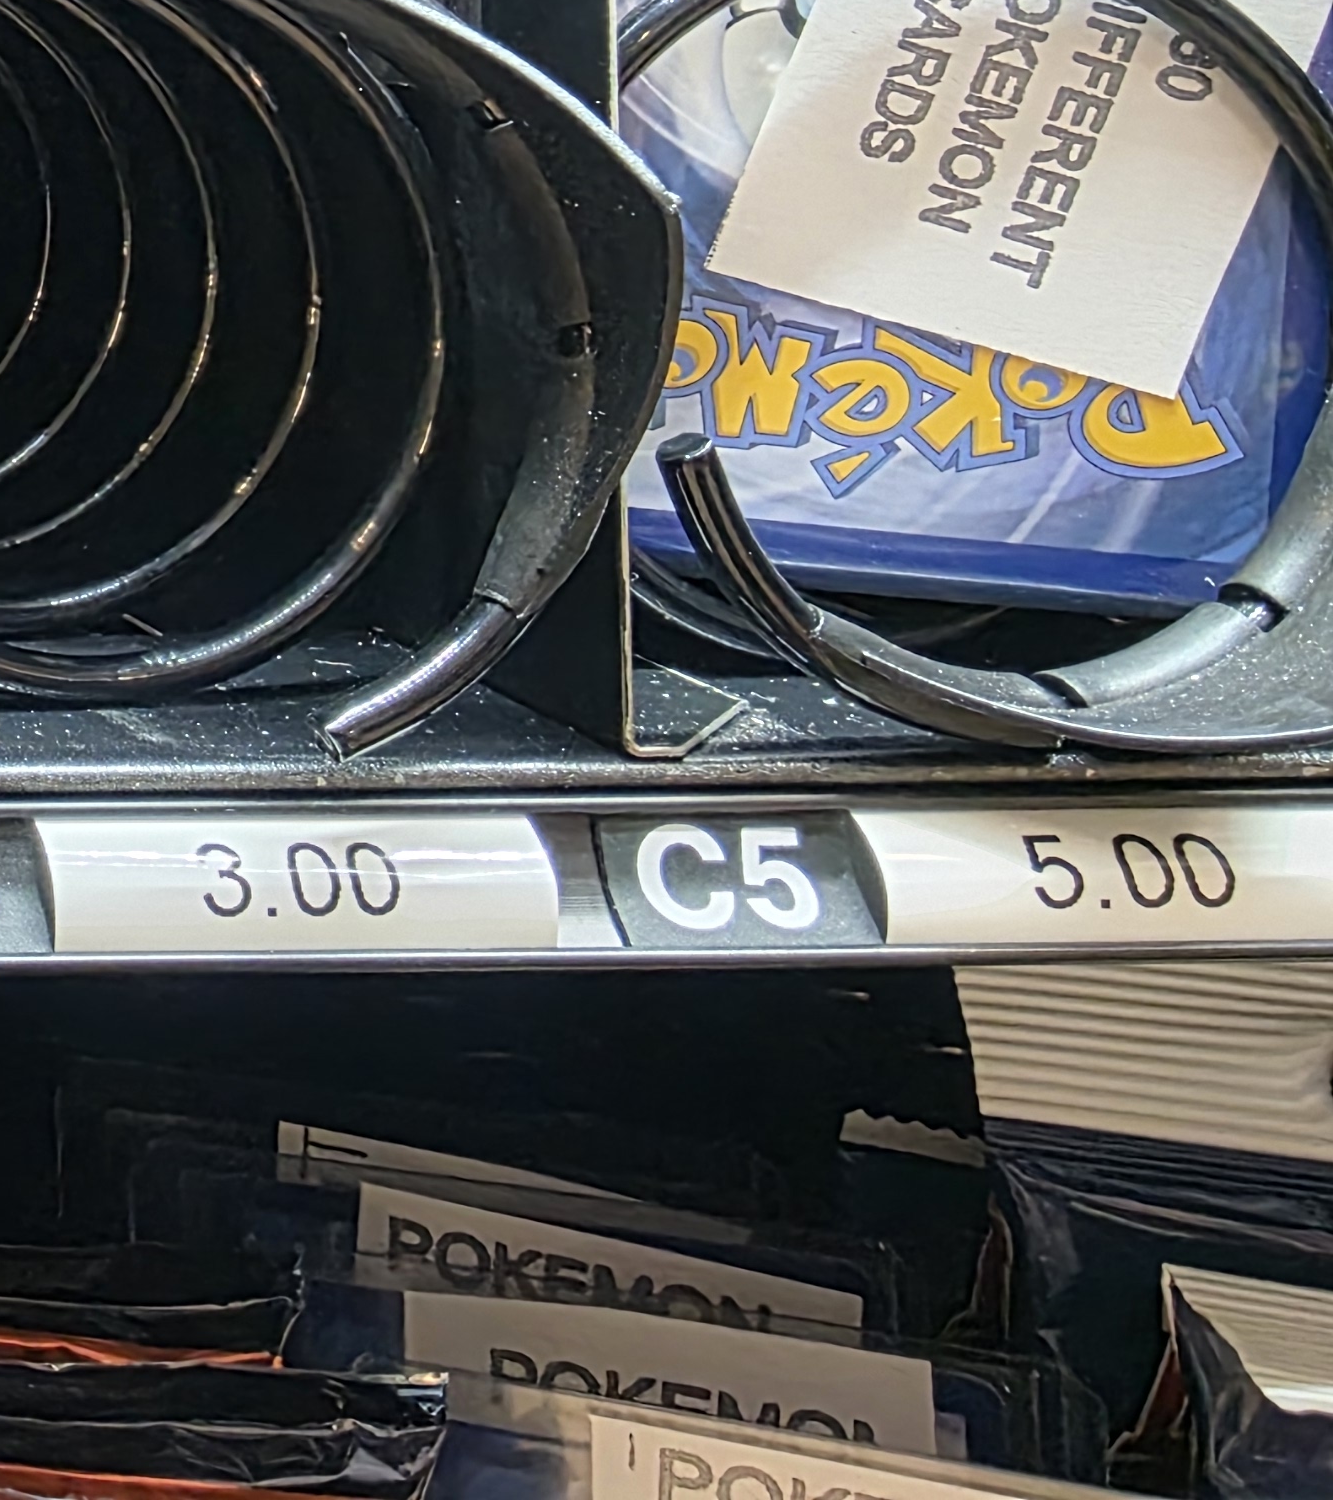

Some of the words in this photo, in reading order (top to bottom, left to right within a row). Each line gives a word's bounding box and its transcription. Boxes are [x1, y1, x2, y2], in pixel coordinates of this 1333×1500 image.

[201, 841, 403, 919] 3.00
[635, 827, 822, 931] C5
[1030, 832, 1237, 911] 5.00
